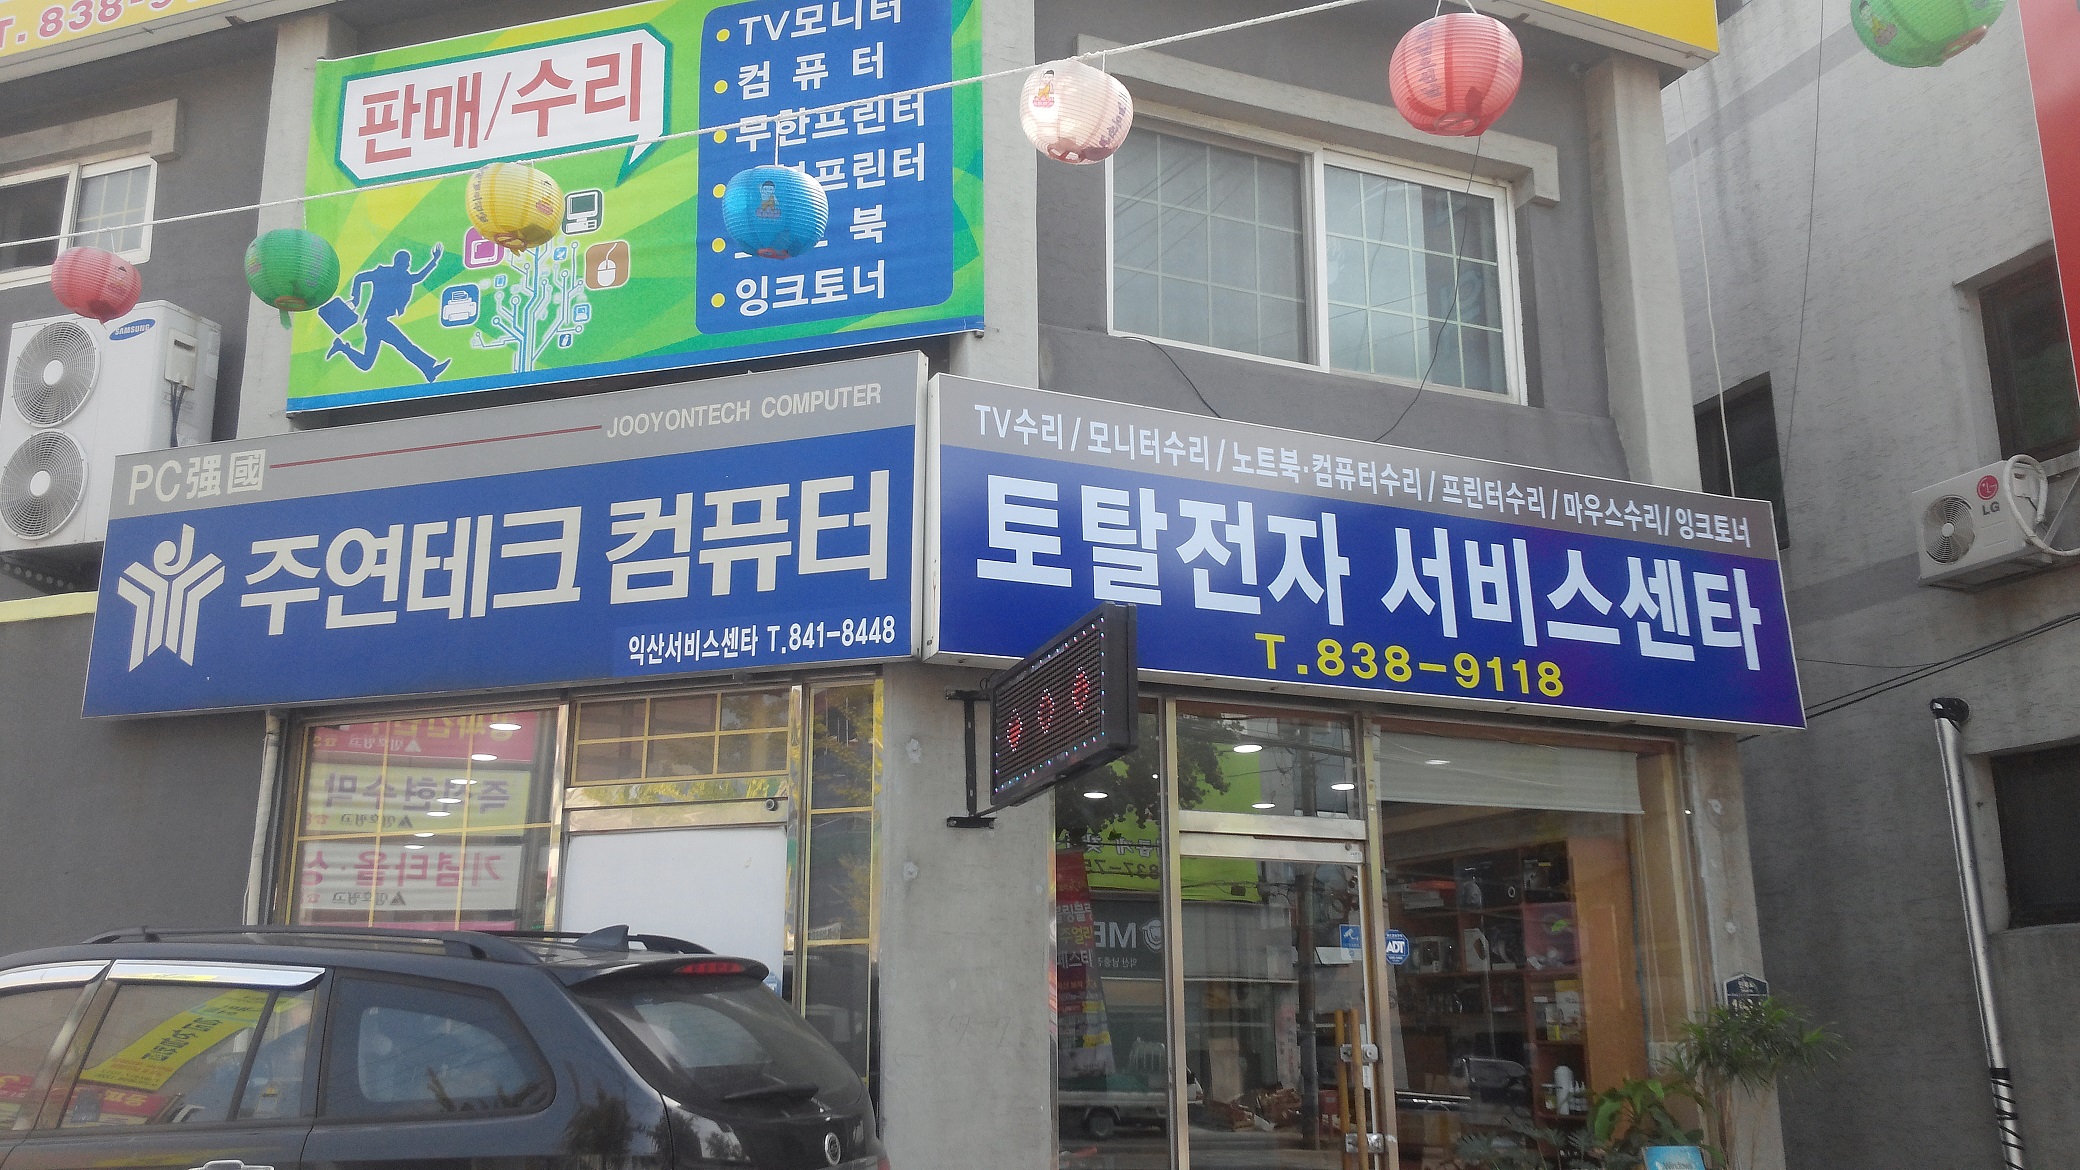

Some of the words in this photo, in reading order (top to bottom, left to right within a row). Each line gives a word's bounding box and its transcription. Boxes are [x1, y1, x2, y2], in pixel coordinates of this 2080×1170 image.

[735, 91, 925, 153] 무한프린터
[782, 142, 925, 192] 프린터
[735, 259, 885, 317] 잉크토너
[115, 323, 151, 336] SAMSUNG
[606, 399, 751, 439] JOOYONTECH
[761, 382, 882, 419] COMPUTER
[1982, 501, 2000, 516] LG
[240, 505, 581, 638] 주연테크
[606, 468, 891, 606] 컴퓨터
[975, 472, 1352, 627] 토탈전자
[1380, 529, 1762, 671] 서비스센타
[628, 623, 759, 667] 익산서비스센타
[1385, 940, 1405, 954] ADT
